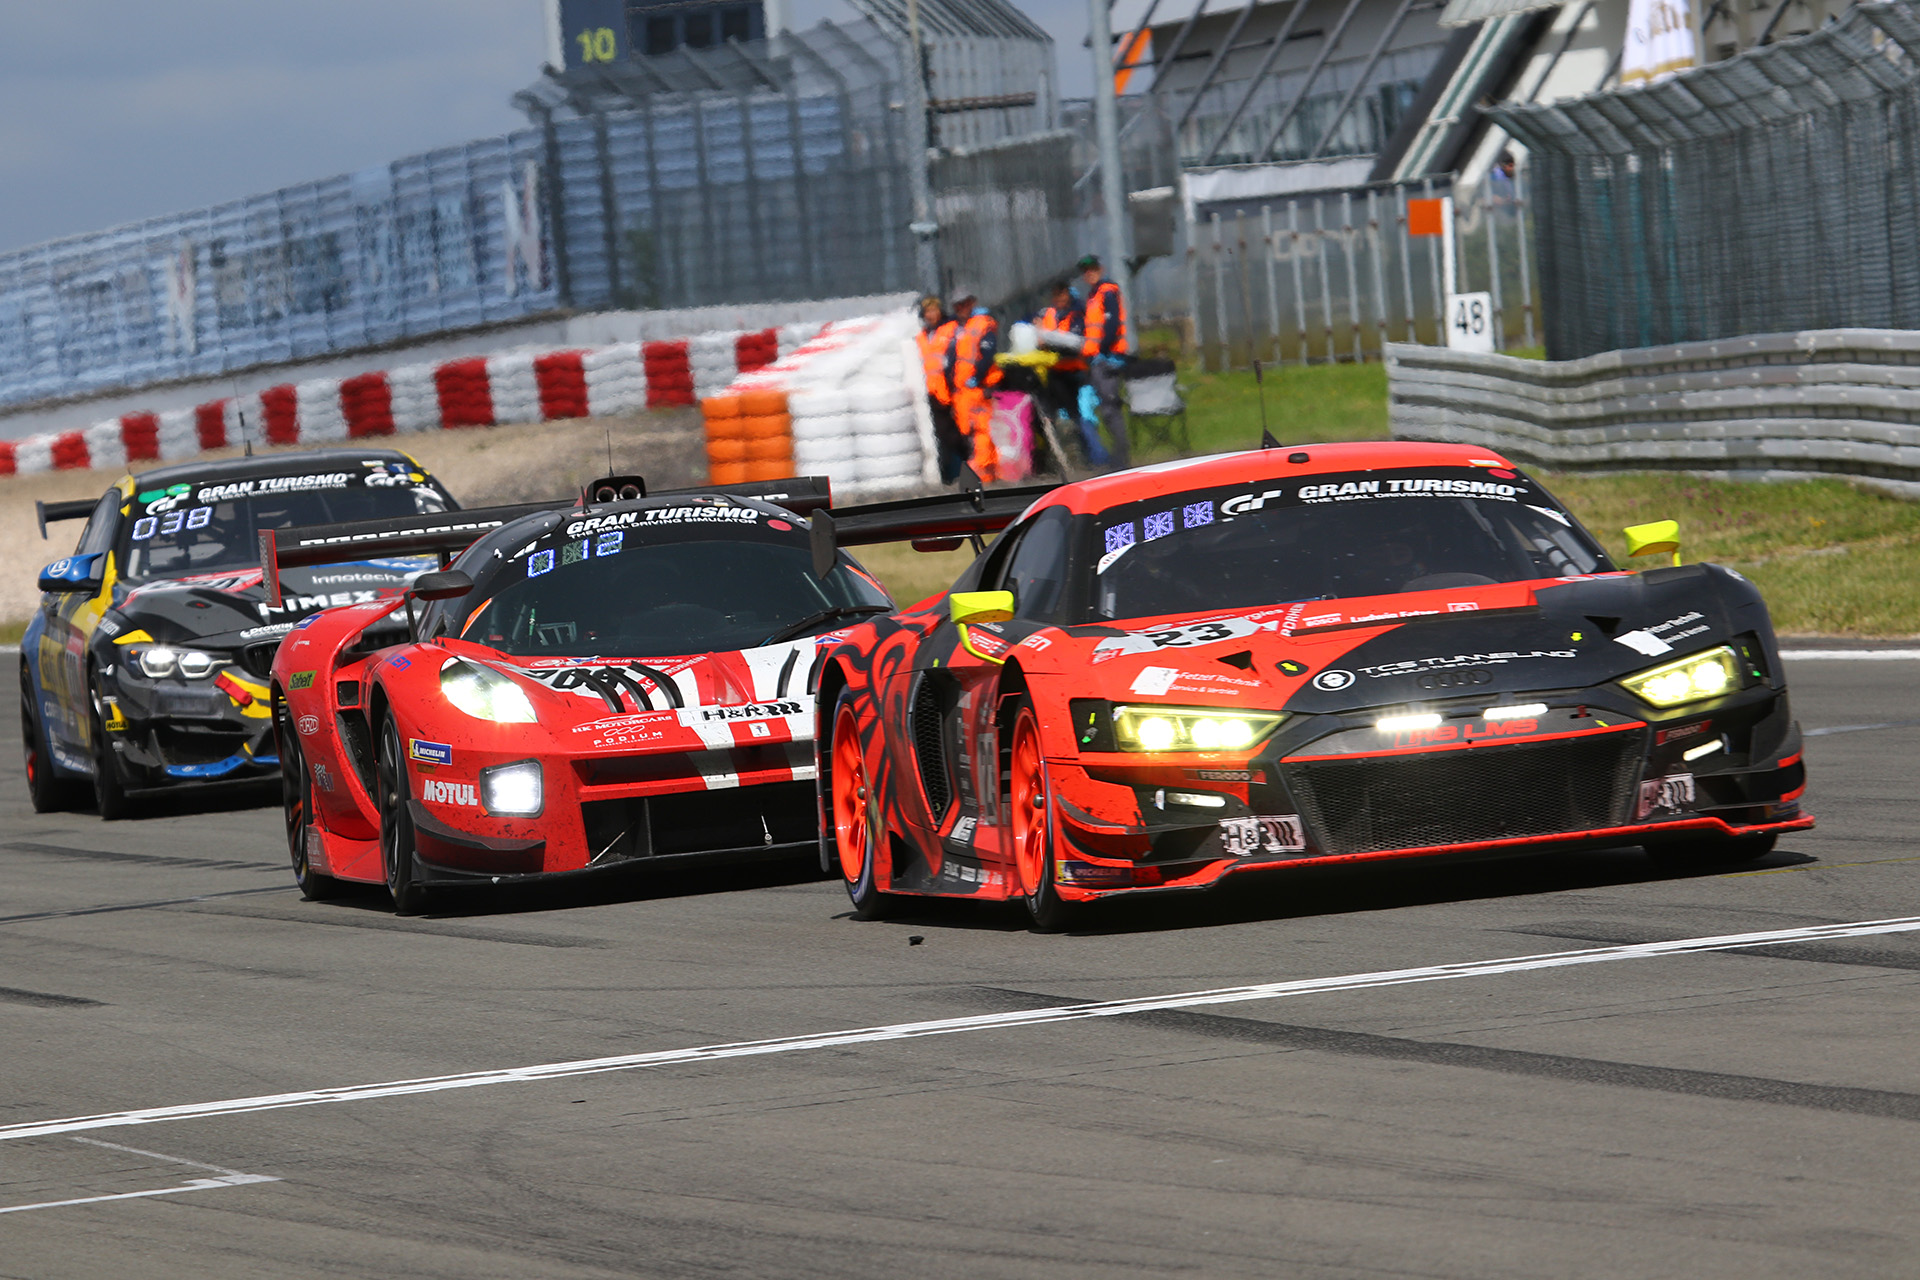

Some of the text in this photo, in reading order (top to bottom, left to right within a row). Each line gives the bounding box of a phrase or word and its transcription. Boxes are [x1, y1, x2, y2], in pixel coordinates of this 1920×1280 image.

[576, 27, 616, 63] 10
[1455, 299, 1484, 335] 48
[197, 481, 254, 500] GRAN
[258, 473, 347, 490] TURISMO
[1298, 479, 1517, 499] GRAN TURISMO
[1302, 497, 1333, 505] THE
[1335, 494, 1374, 502] REAL
[1432, 492, 1518, 502] SIMULATOR
[132, 506, 212, 541] 038
[566, 506, 758, 535] GRAN TURISMO
[569, 517, 757, 539] THE REAL DRIVING SIMULATOR
[1305, 616, 1342, 627] BOSCH
[1144, 623, 1234, 648] 23
[1357, 651, 1577, 675] TCS TUNNELING
[290, 671, 313, 689] Sabelt
[1216, 674, 1261, 687] Technik
[572, 715, 673, 734] HK MOTORCARS
[1407, 718, 1538, 744] R8 LMS
[593, 731, 663, 746] PODIUM
[419, 746, 446, 758] MICHELIN
[1200, 769, 1250, 781] FERODO
[423, 779, 478, 806] MOTUL
